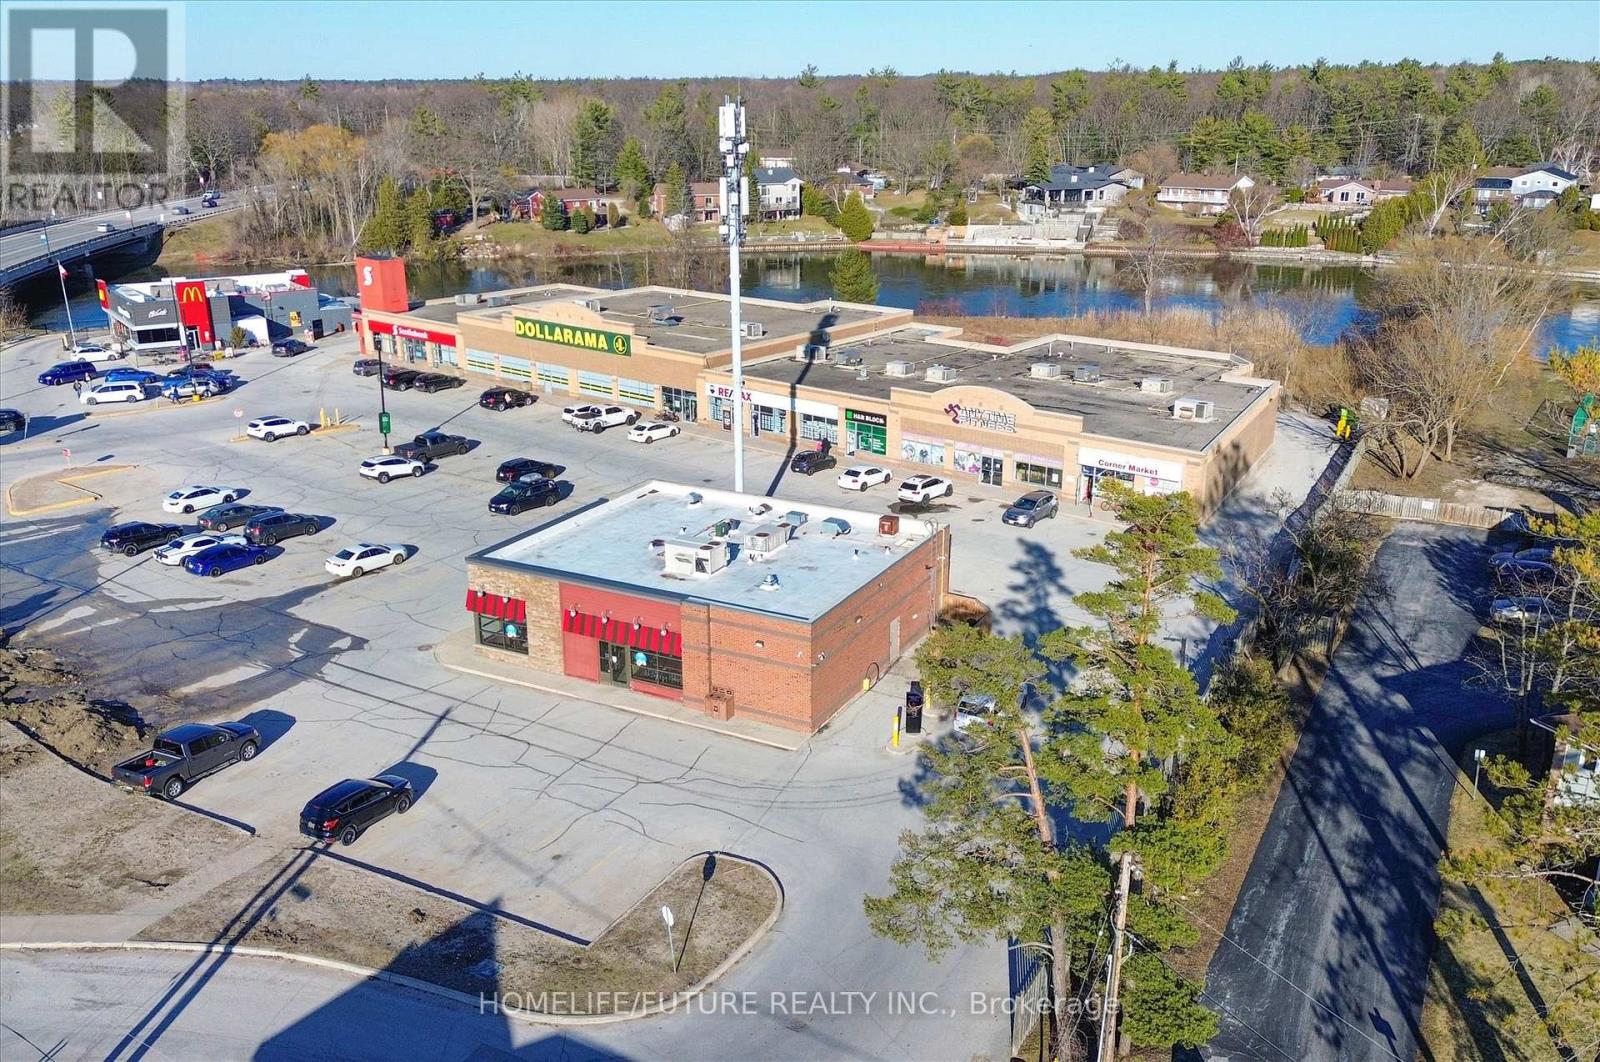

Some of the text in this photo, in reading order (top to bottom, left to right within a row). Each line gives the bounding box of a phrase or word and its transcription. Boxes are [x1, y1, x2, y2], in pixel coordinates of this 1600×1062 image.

[399, 328, 428, 339] Scotiabank
[515, 320, 608, 350] DOLLARAMA
[718, 387, 752, 402] RE/AX
[959, 406, 1015, 425] ANYTIME
[959, 416, 1016, 433] FITNESS
[1098, 459, 1158, 476] Corner Market
